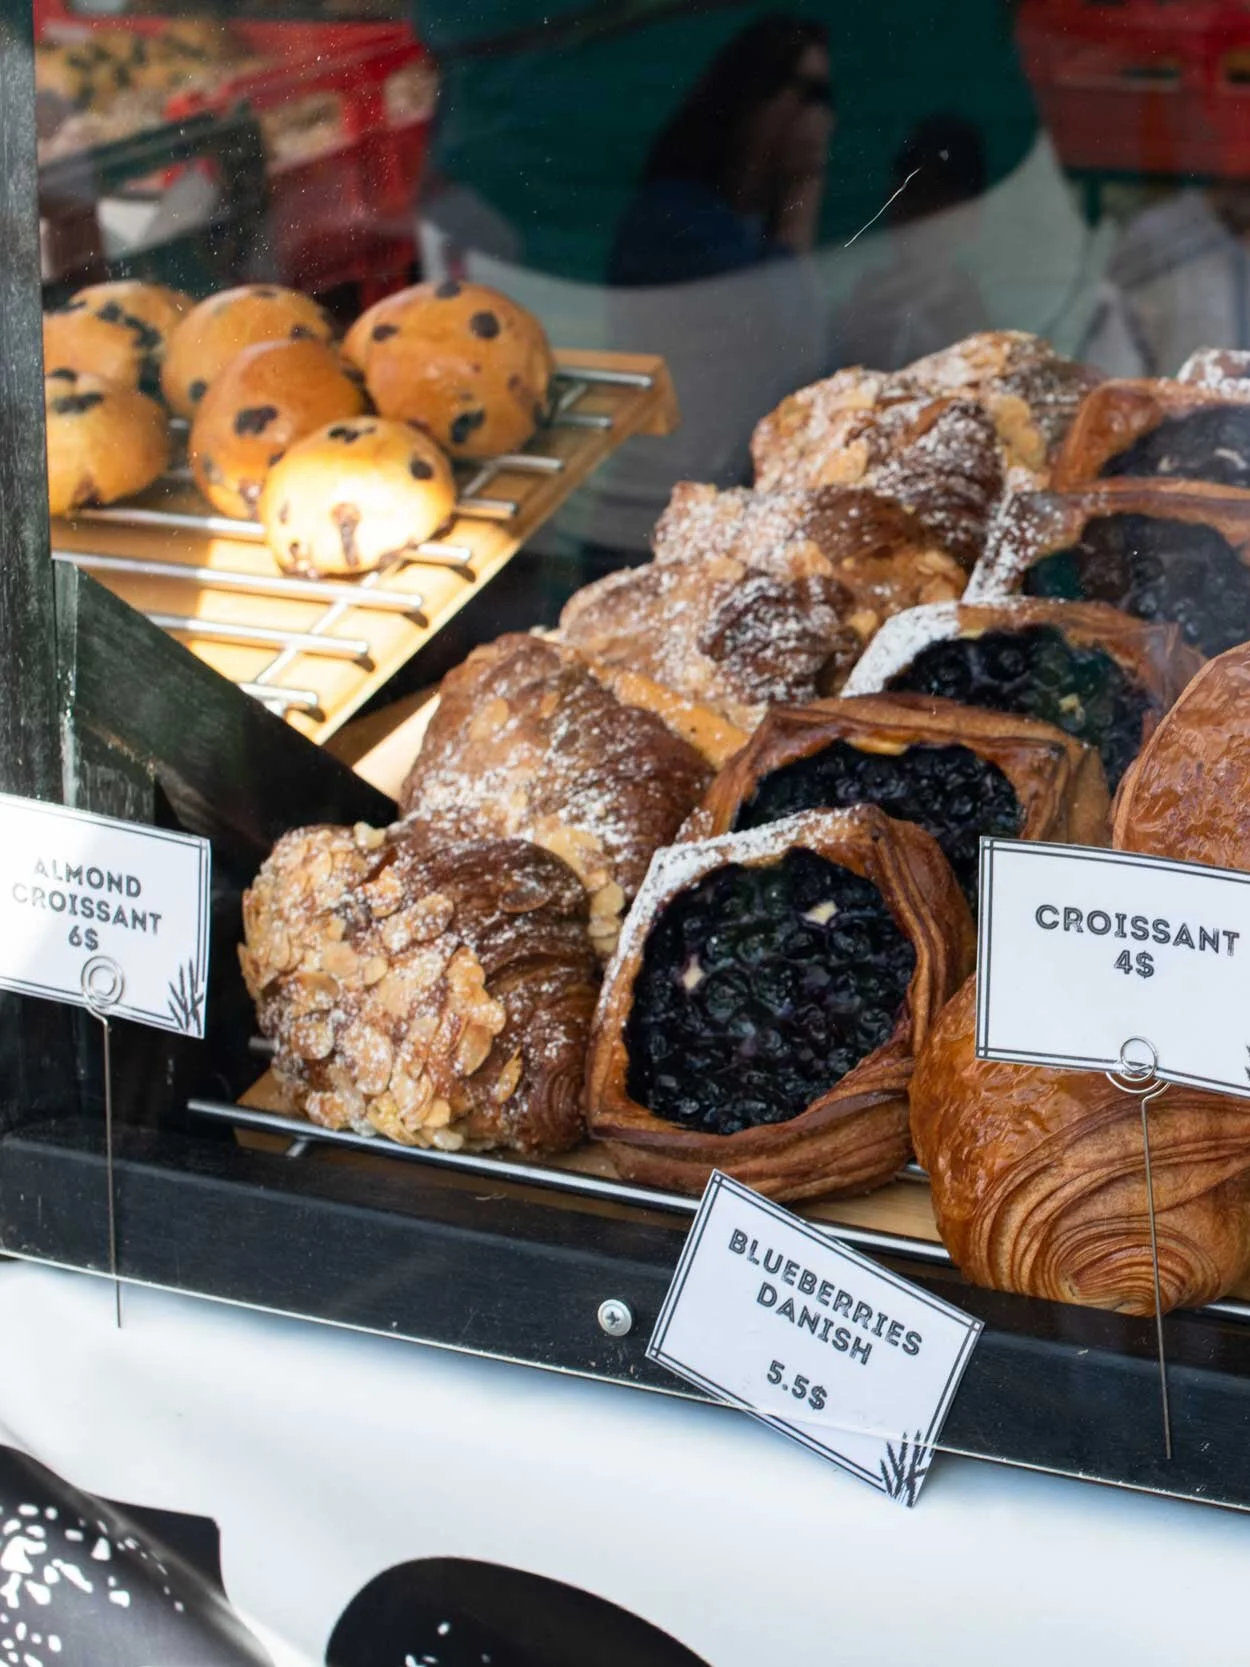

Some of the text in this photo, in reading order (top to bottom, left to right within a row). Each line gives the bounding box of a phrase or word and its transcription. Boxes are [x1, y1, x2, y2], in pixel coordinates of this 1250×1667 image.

[33, 857, 142, 899] ALMOND
[11, 882, 162, 935] CROISSANT
[1035, 905, 1240, 957] CROISSANT
[68, 925, 99, 952] 6$
[1114, 949, 1155, 979] 4$
[728, 1228, 923, 1356] BLUEBERRIES
[756, 1281, 873, 1365] DANISH
[766, 1359, 828, 1410] 5.5$
